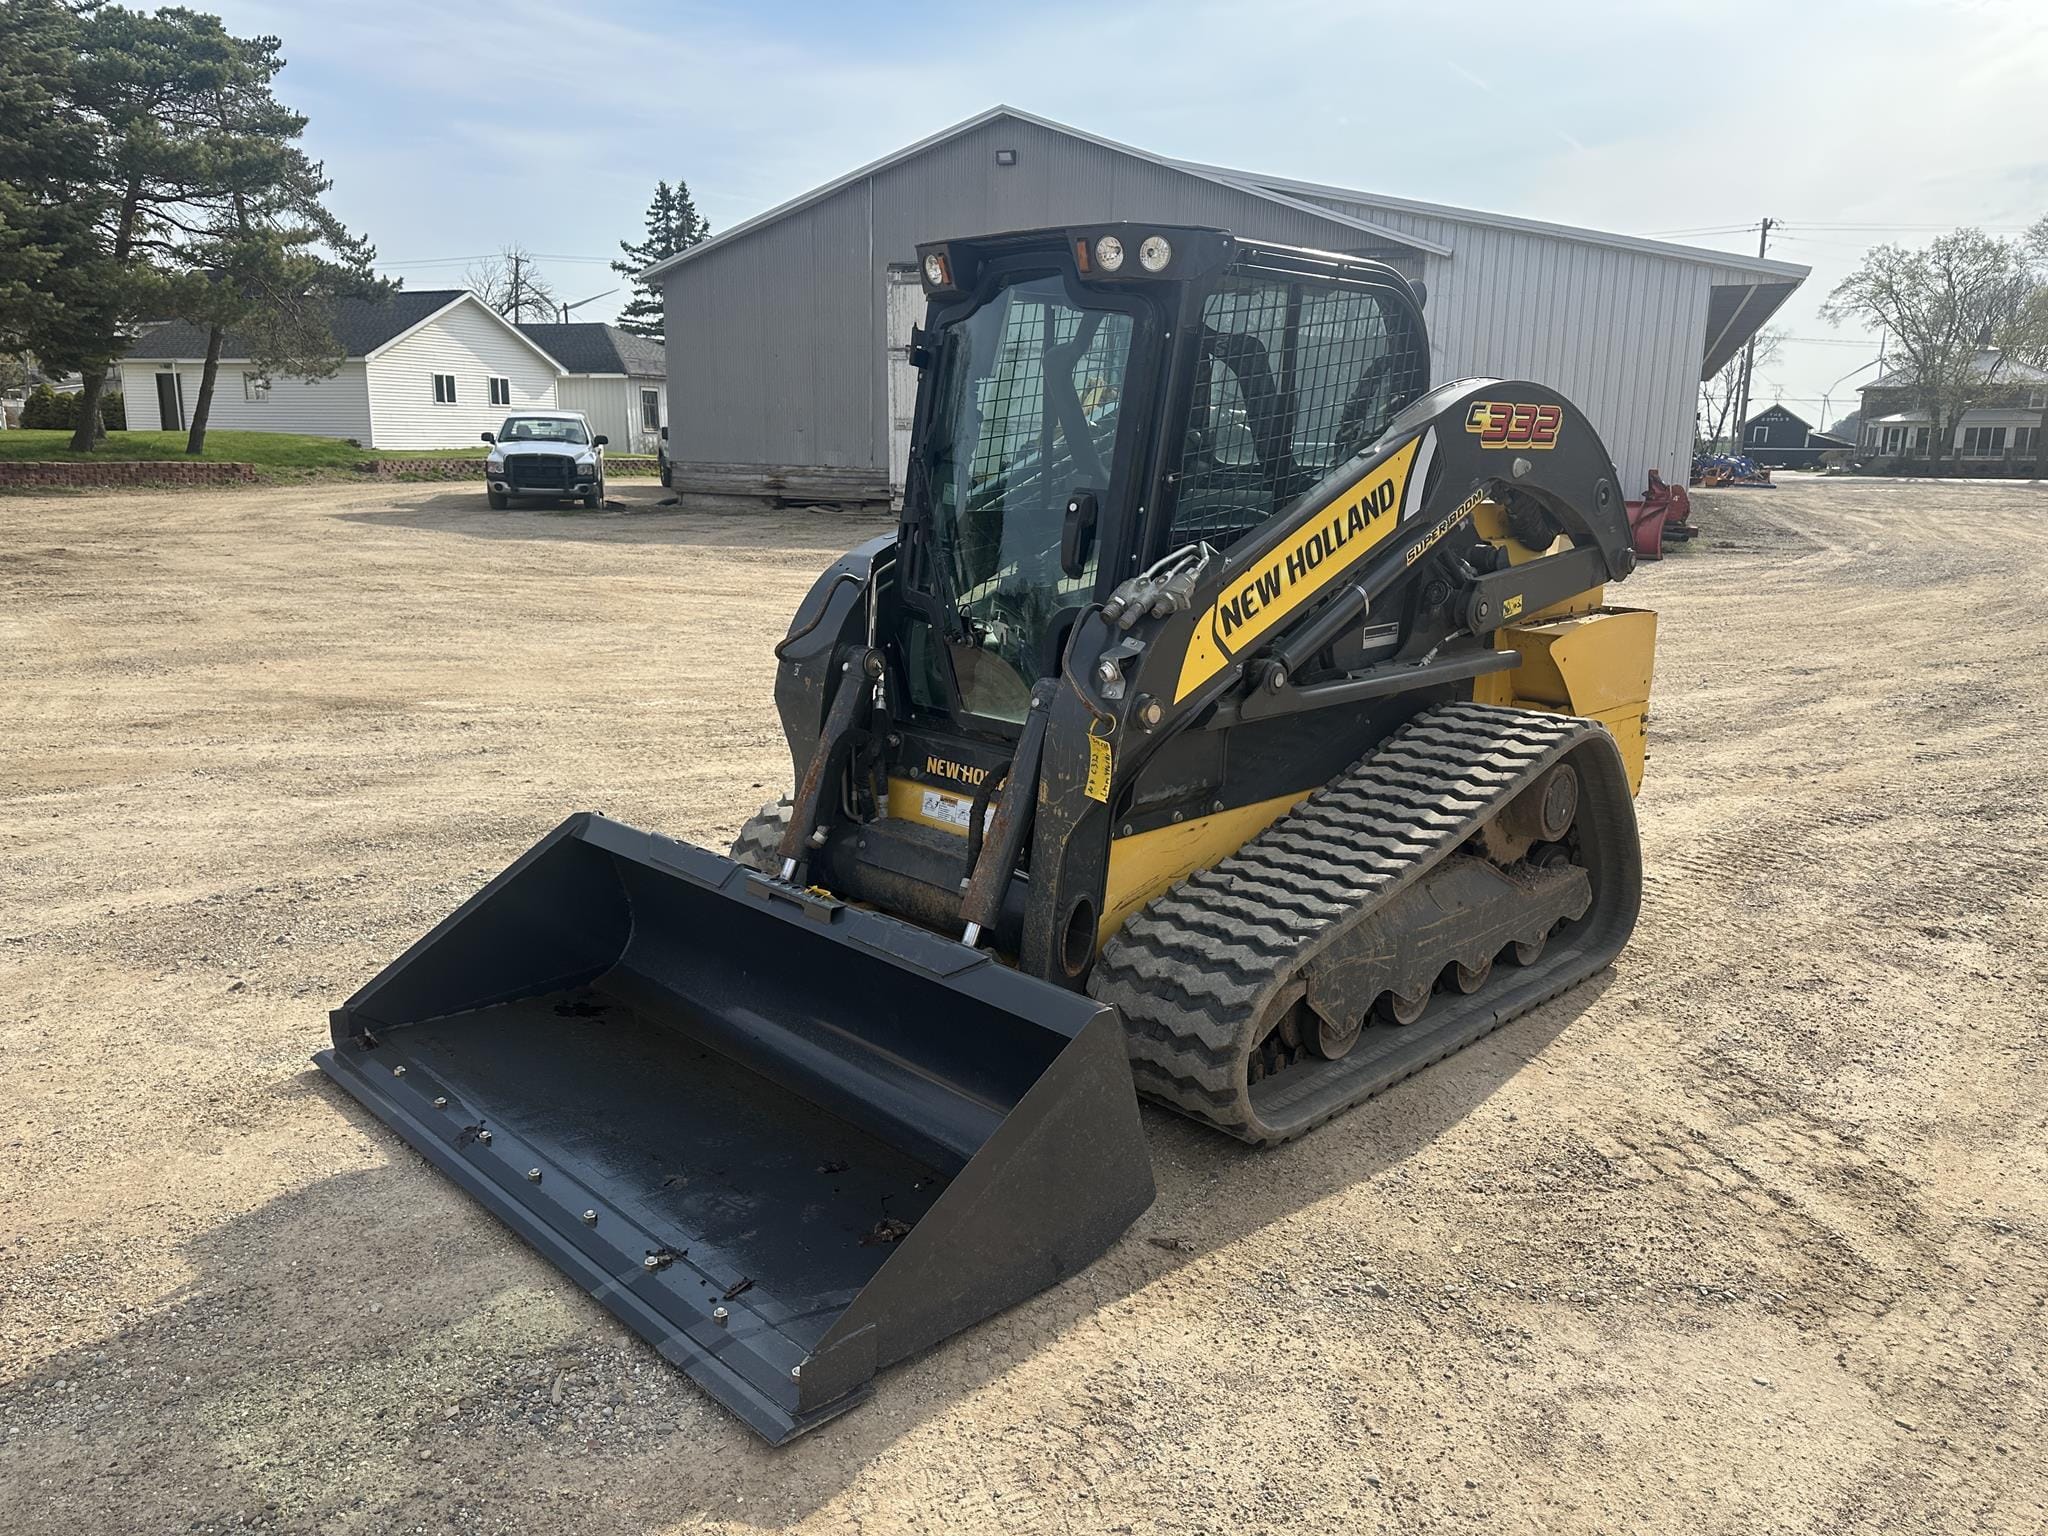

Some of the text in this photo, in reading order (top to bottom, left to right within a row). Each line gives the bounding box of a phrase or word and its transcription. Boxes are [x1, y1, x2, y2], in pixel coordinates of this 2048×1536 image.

[1465, 401, 1562, 449] C332
[1220, 478, 1395, 637] NEW HOLLAND
[1407, 489, 1483, 566] SUPER BOOM
[926, 756, 961, 780] NEW
